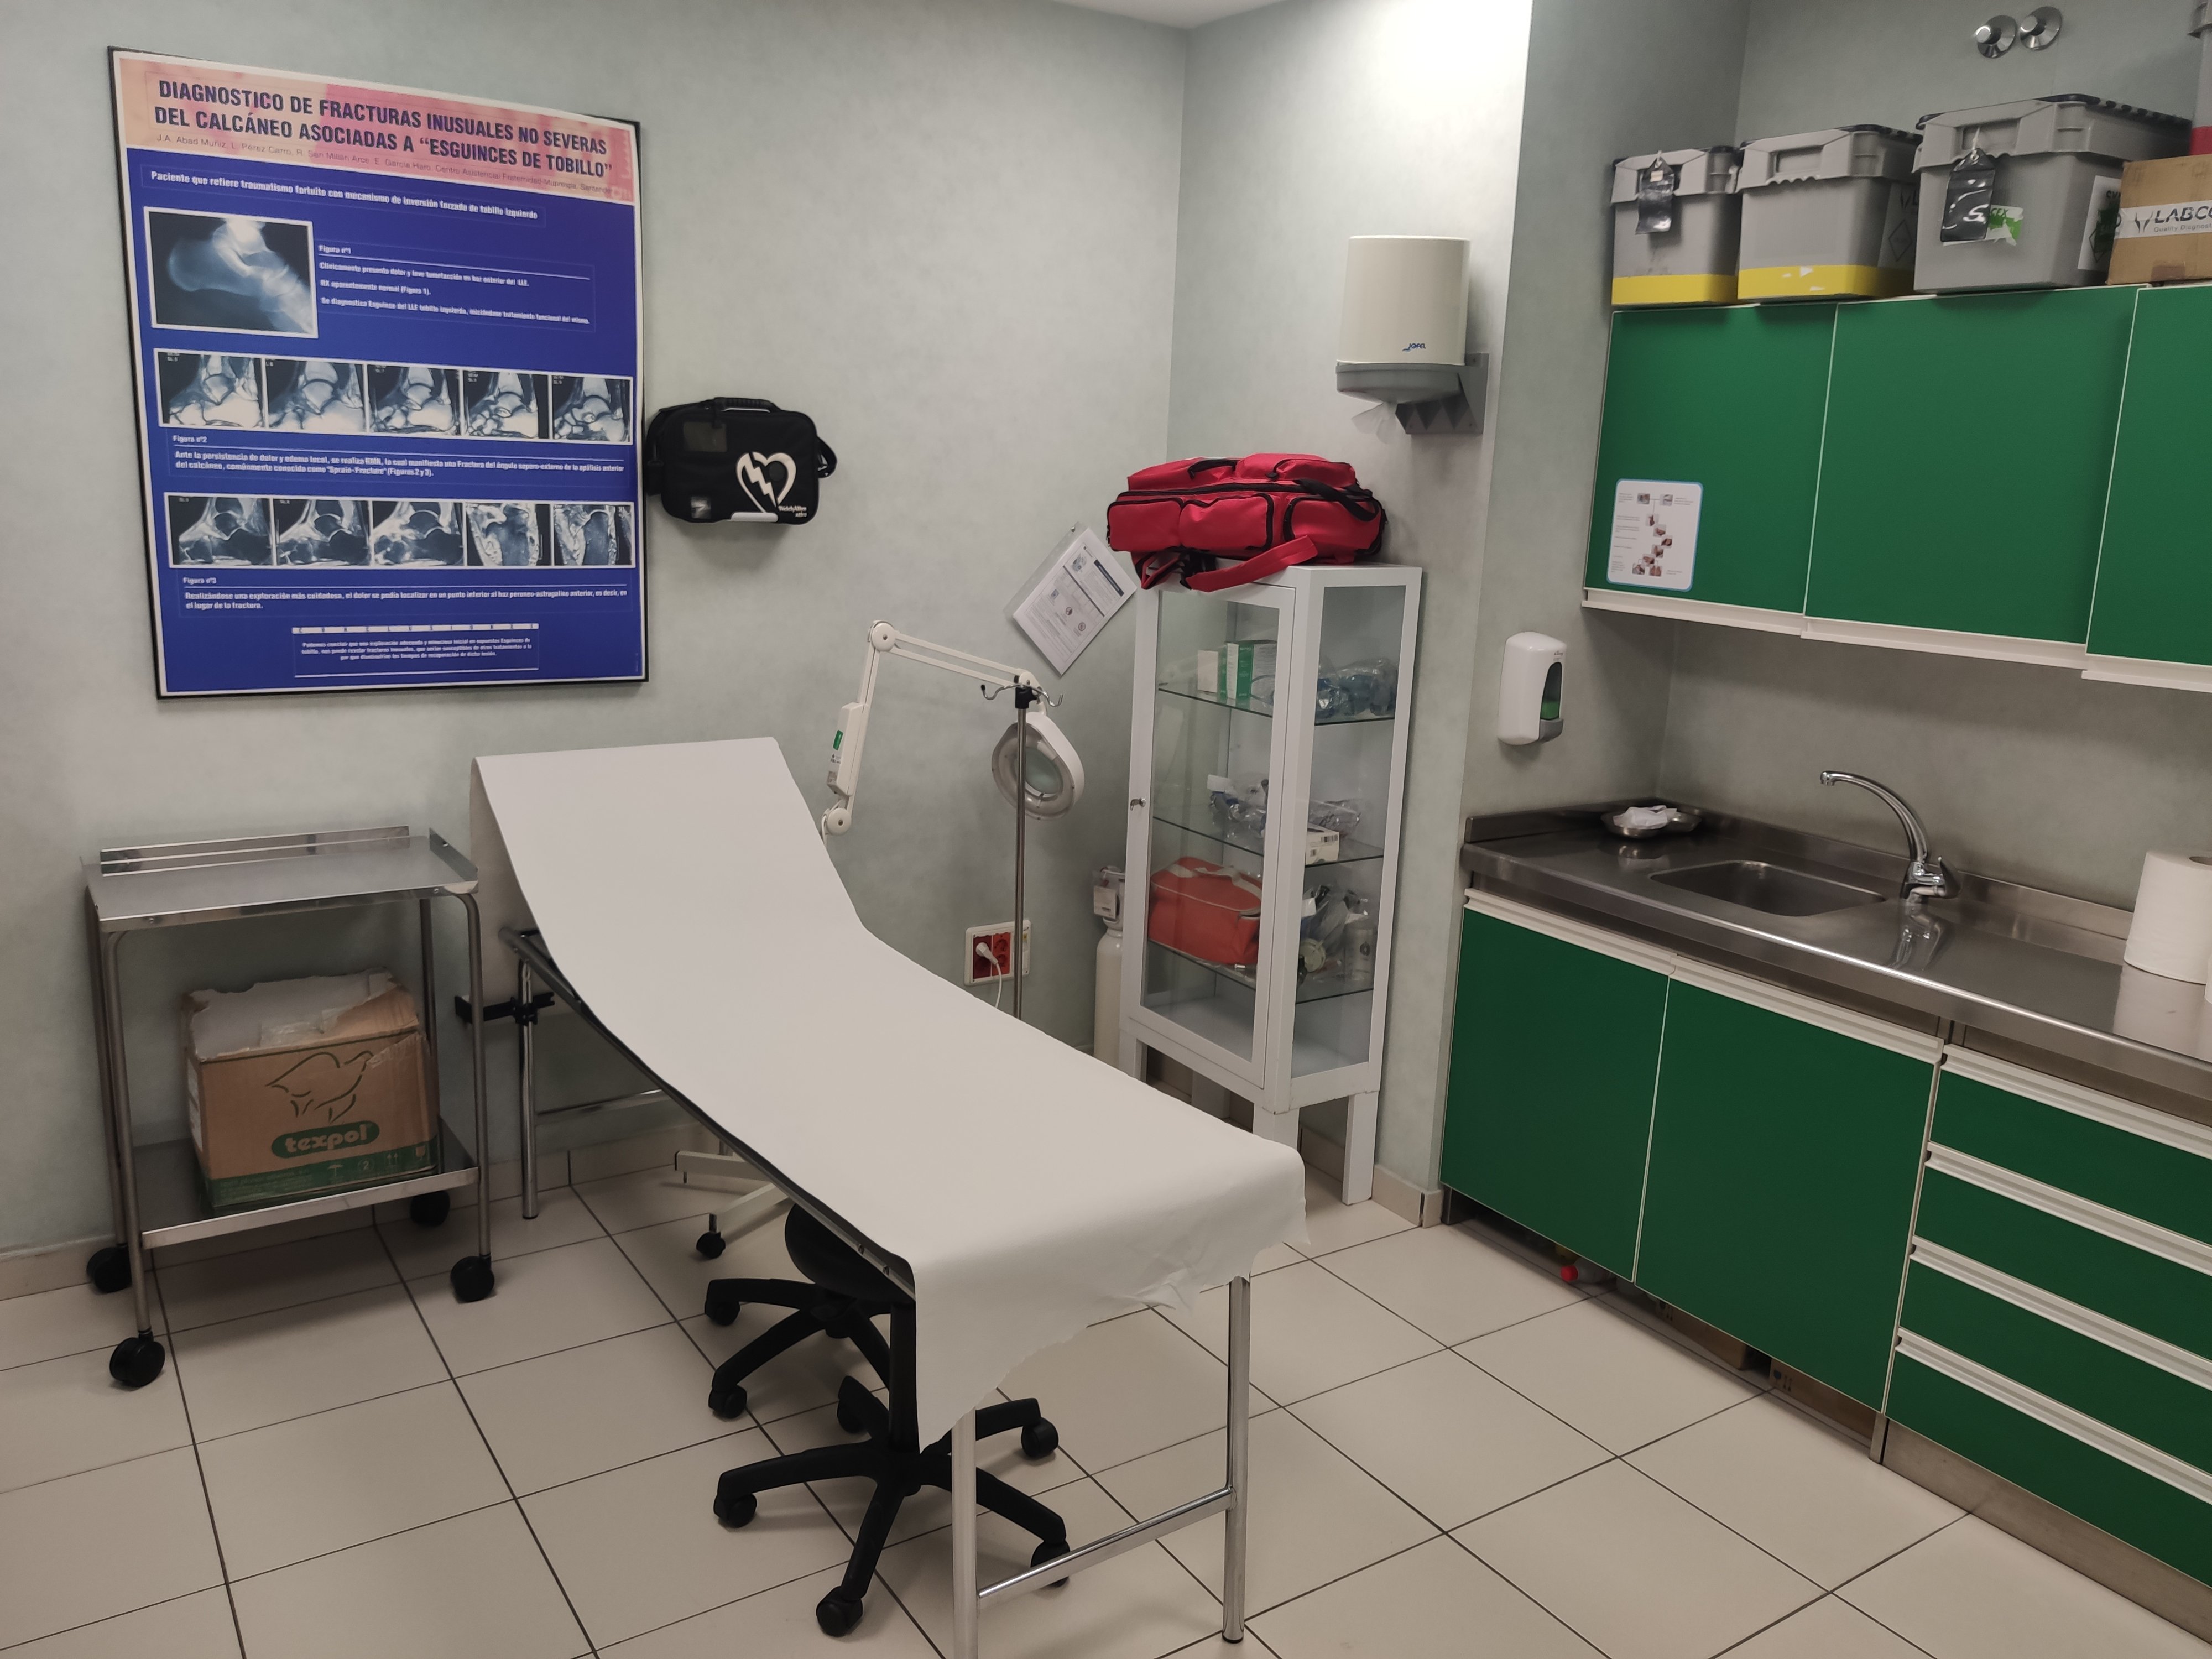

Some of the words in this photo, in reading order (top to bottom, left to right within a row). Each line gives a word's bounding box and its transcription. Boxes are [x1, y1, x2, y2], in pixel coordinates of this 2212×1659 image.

[159, 80, 284, 111] DIAGNOSTICO
[290, 96, 313, 114] DE
[319, 100, 421, 128] FRACTURAS
[427, 113, 514, 140] INUSUALES
[518, 127, 539, 144] NO
[543, 129, 607, 154] SEVERAS
[155, 107, 190, 127] DEL
[196, 111, 293, 138] CALCÁNEO
[299, 124, 397, 150] ASOCIADAS
[403, 136, 414, 152] A
[523, 152, 541, 168] DE
[176, 135, 198, 145] Abad
[152, 171, 190, 182] Paciente
[192, 177, 208, 185] que
[210, 178, 239, 187] refiere
[241, 180, 293, 193] traumatismo
[295, 186, 326, 196] fortuito
[392, 195, 401, 204] de
[440, 201, 467, 211] forzado
[480, 206, 503, 215] tobillo
[505, 208, 538, 218] izquierdo
[319, 245, 340, 253] Figura
[1404, 343, 1426, 351] JOFEL
[284, 1124, 368, 1153] texpol
